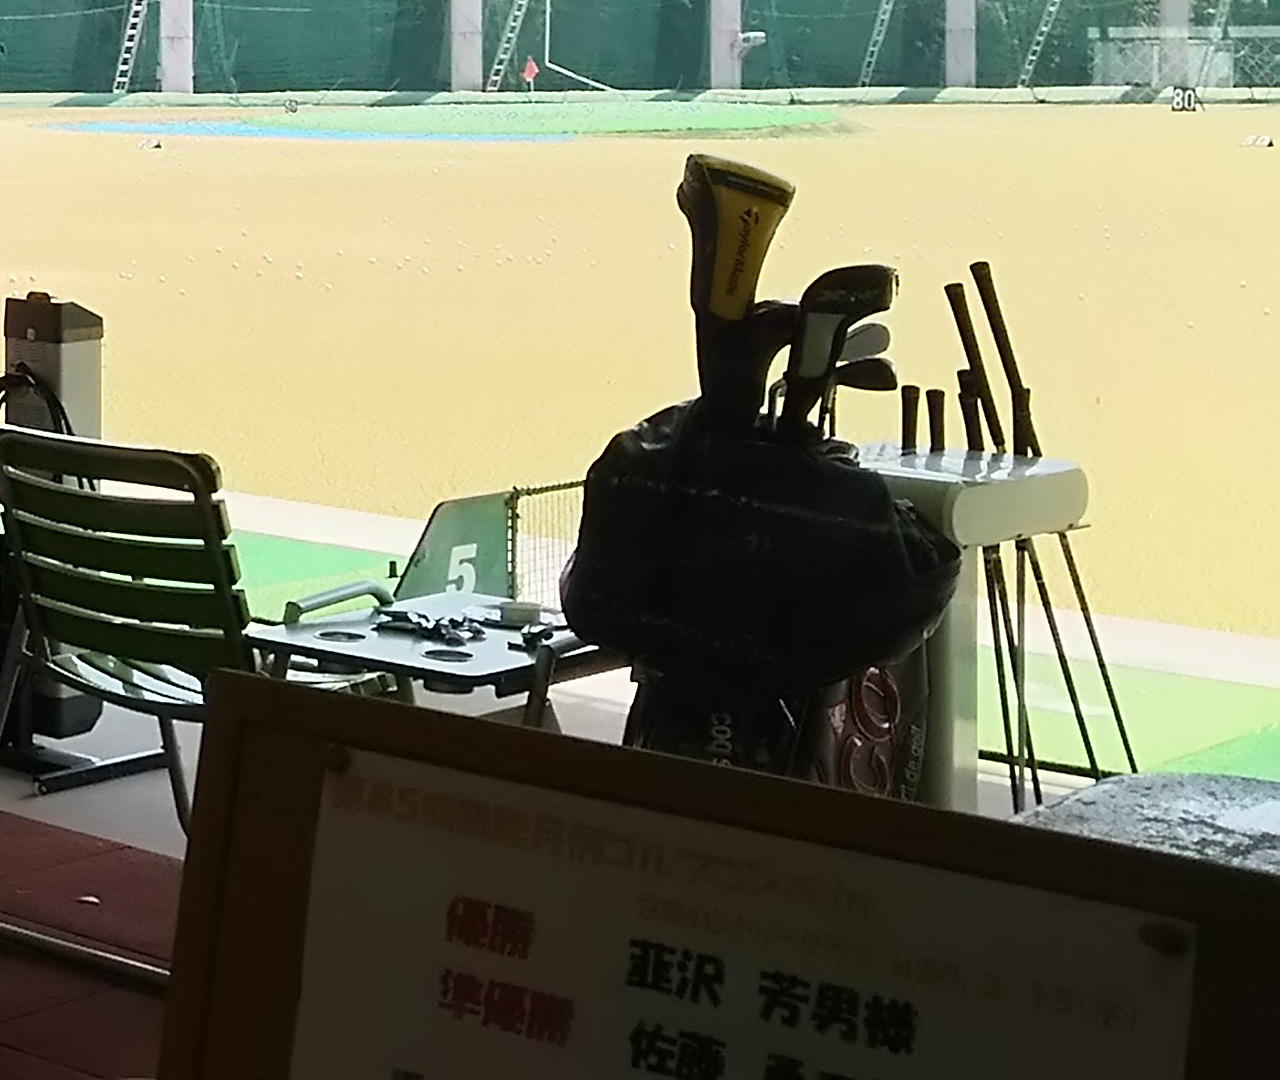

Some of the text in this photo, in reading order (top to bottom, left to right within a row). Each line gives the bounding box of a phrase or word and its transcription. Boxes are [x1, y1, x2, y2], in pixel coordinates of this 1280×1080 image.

[1172, 88, 1195, 110] 80
[445, 543, 478, 594] 5
[445, 894, 536, 960] 優勝
[438, 967, 576, 1047] 準優勝
[758, 969, 919, 1056] 芳男様
